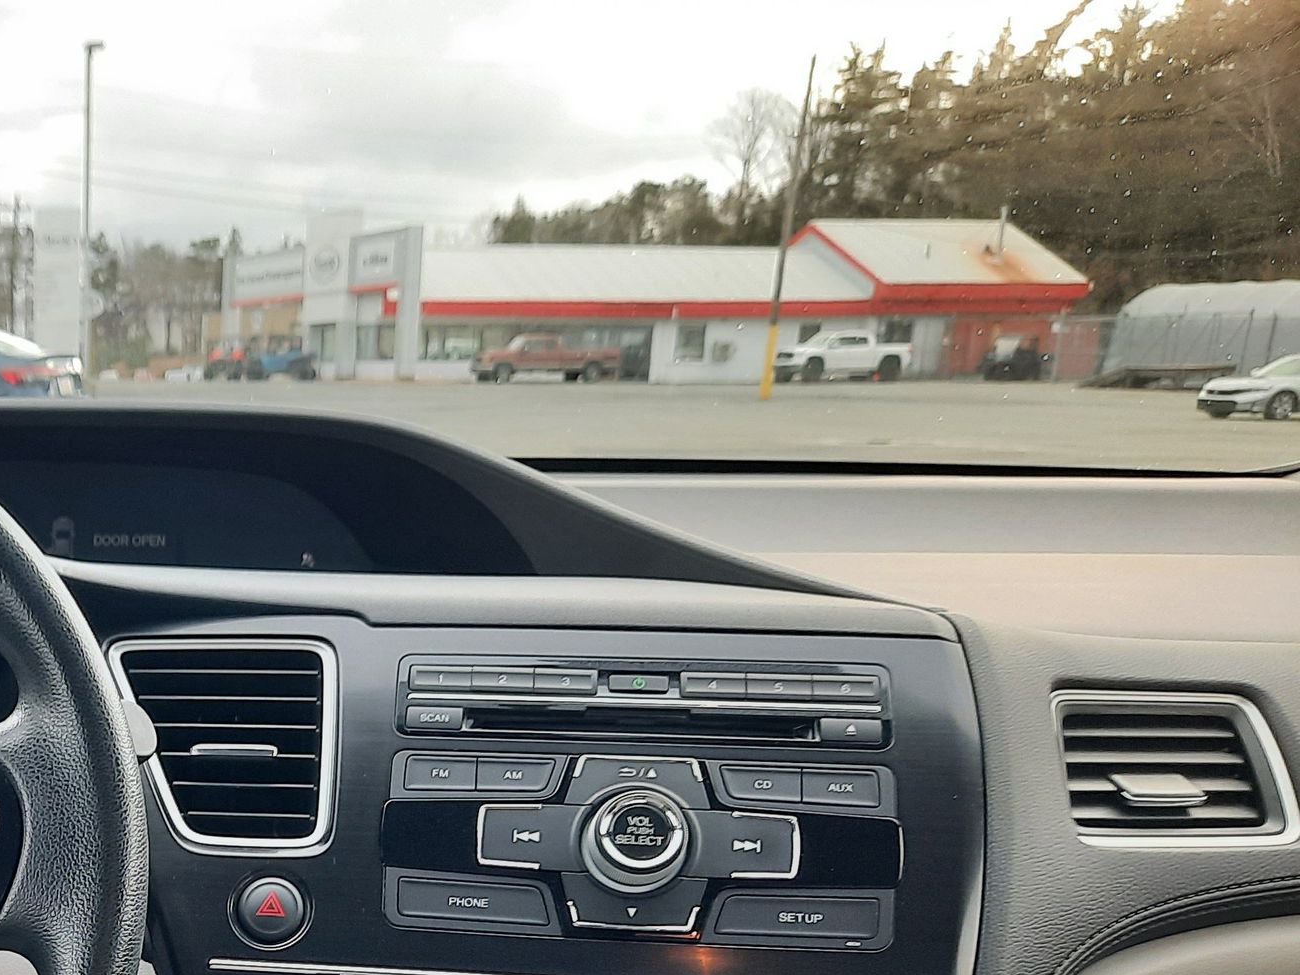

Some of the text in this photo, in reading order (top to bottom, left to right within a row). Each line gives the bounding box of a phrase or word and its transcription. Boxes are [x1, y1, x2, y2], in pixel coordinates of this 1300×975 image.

[93, 534, 165, 547] DOOR OPEN
[436, 673, 446, 684] 1
[496, 673, 510, 685] 2
[558, 674, 573, 687] 3
[704, 679, 721, 691] 4
[771, 681, 787, 693] 5
[838, 682, 854, 693] 6
[417, 713, 453, 725] SCAN
[431, 768, 450, 778] FM
[503, 770, 523, 780] AM
[753, 779, 773, 790] CD
[827, 783, 853, 793] AUX
[626, 815, 654, 827] VOL
[626, 826, 655, 835] PUSH
[614, 834, 664, 846] SELECT
[448, 896, 488, 909] PHONE
